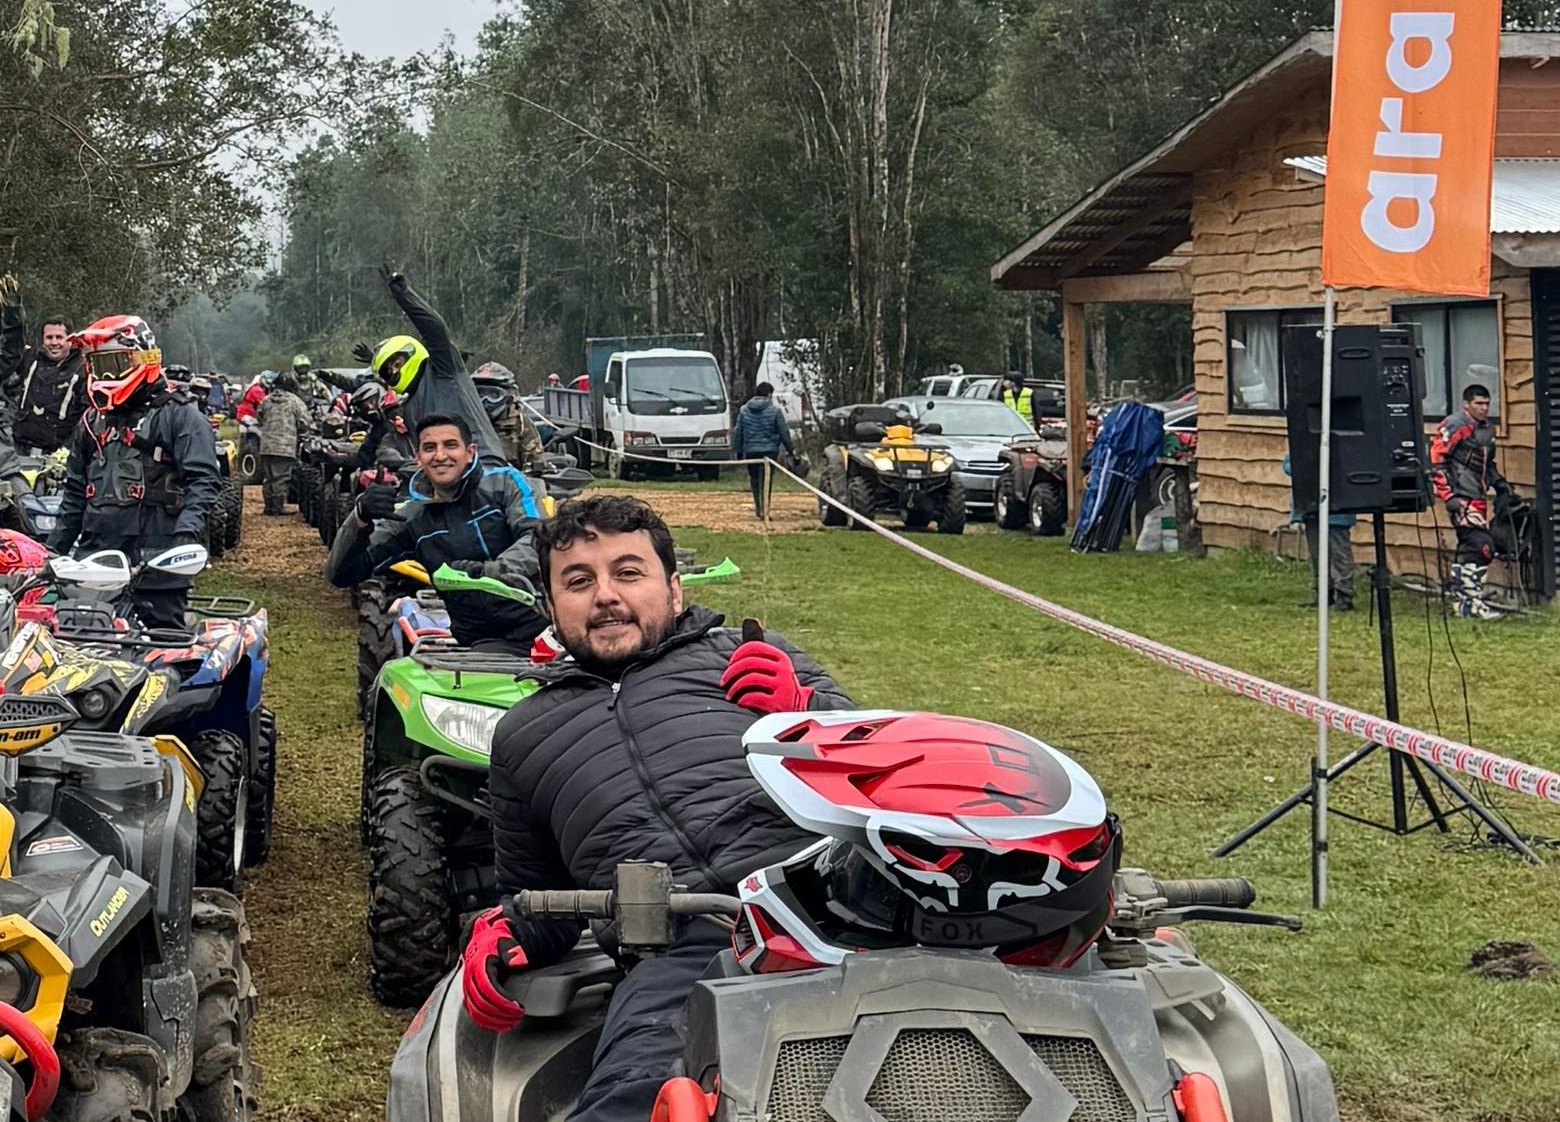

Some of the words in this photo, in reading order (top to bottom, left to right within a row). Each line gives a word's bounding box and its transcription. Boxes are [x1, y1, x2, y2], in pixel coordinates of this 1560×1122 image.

[1360, 12, 1455, 253] ara
[90, 885, 130, 938] OUTLANDER
[920, 919, 984, 940] FOX
